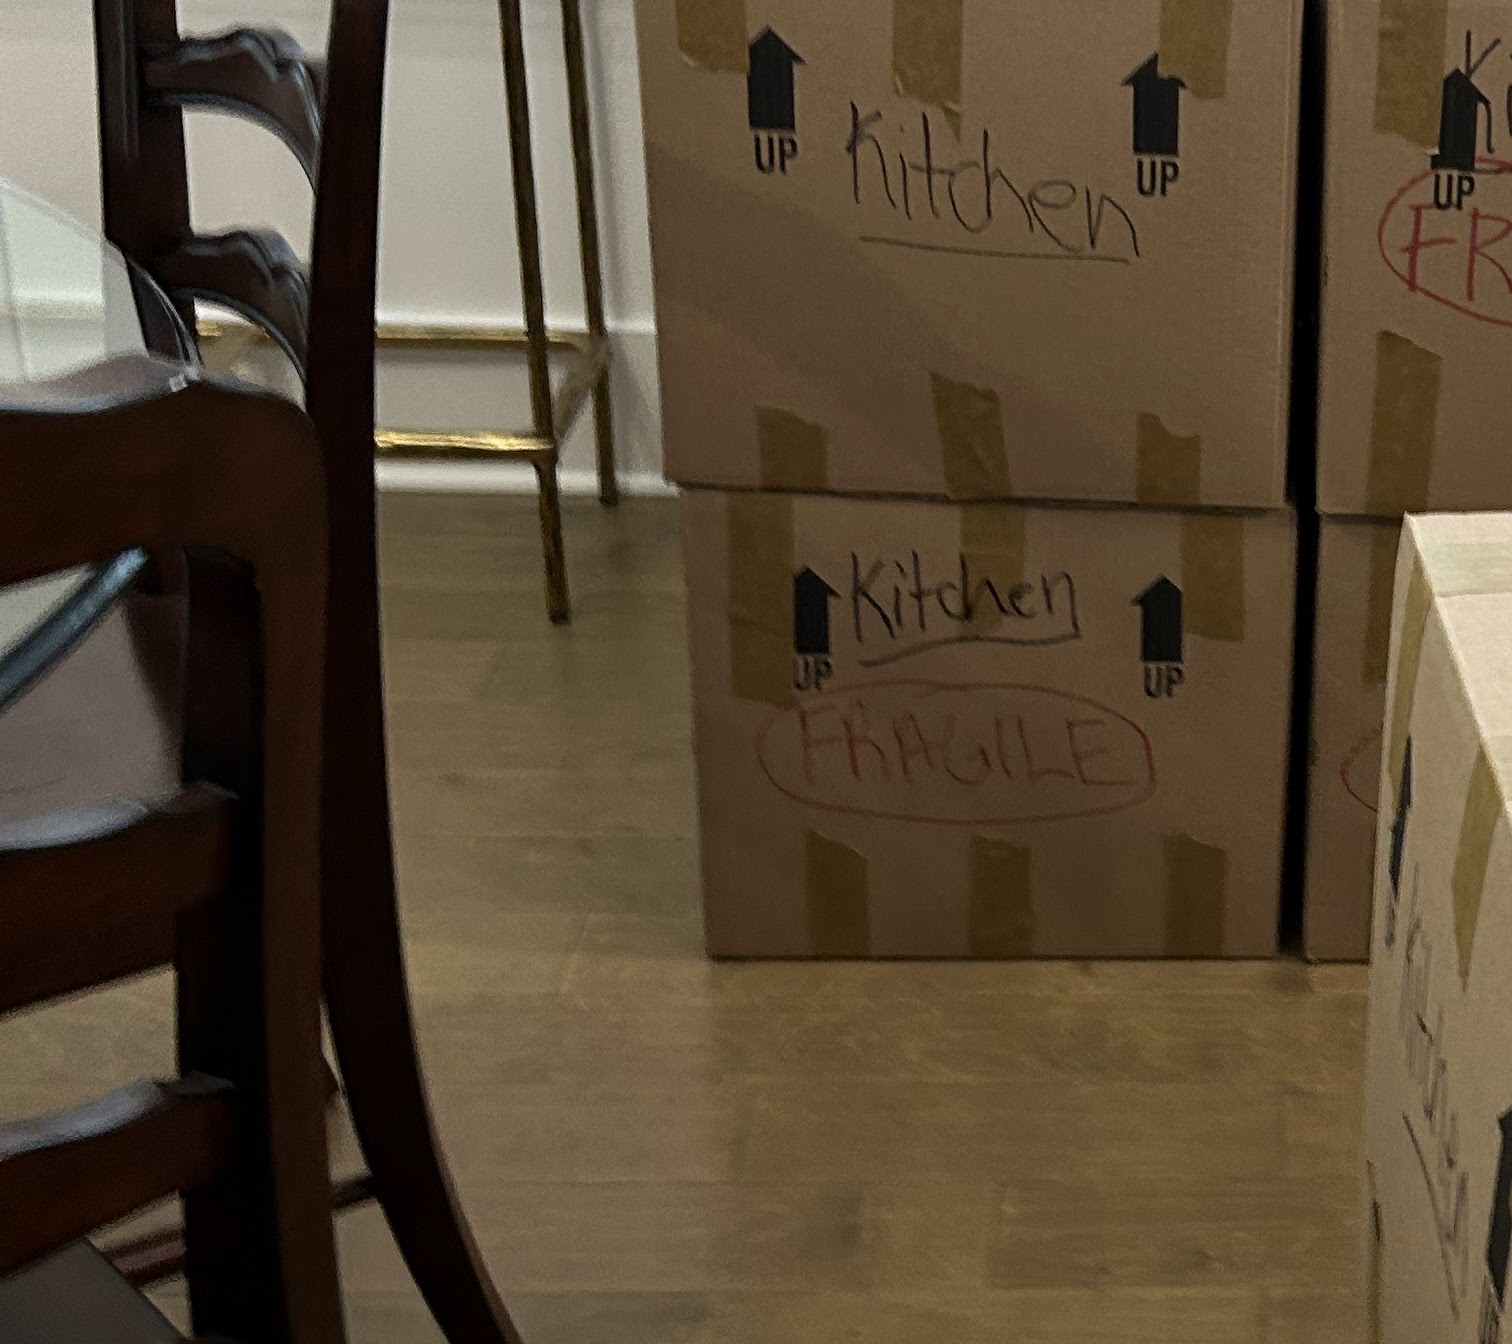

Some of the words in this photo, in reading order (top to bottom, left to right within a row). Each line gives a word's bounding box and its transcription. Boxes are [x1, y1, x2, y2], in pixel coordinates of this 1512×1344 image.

[752, 135, 798, 175] UP
[846, 100, 1141, 257] Kitchen
[1135, 159, 1180, 197] UP
[1434, 173, 1475, 211] UP
[851, 549, 1081, 645] Kitchen
[1142, 665, 1184, 699] UP
[799, 699, 1136, 786] FRAGILE
